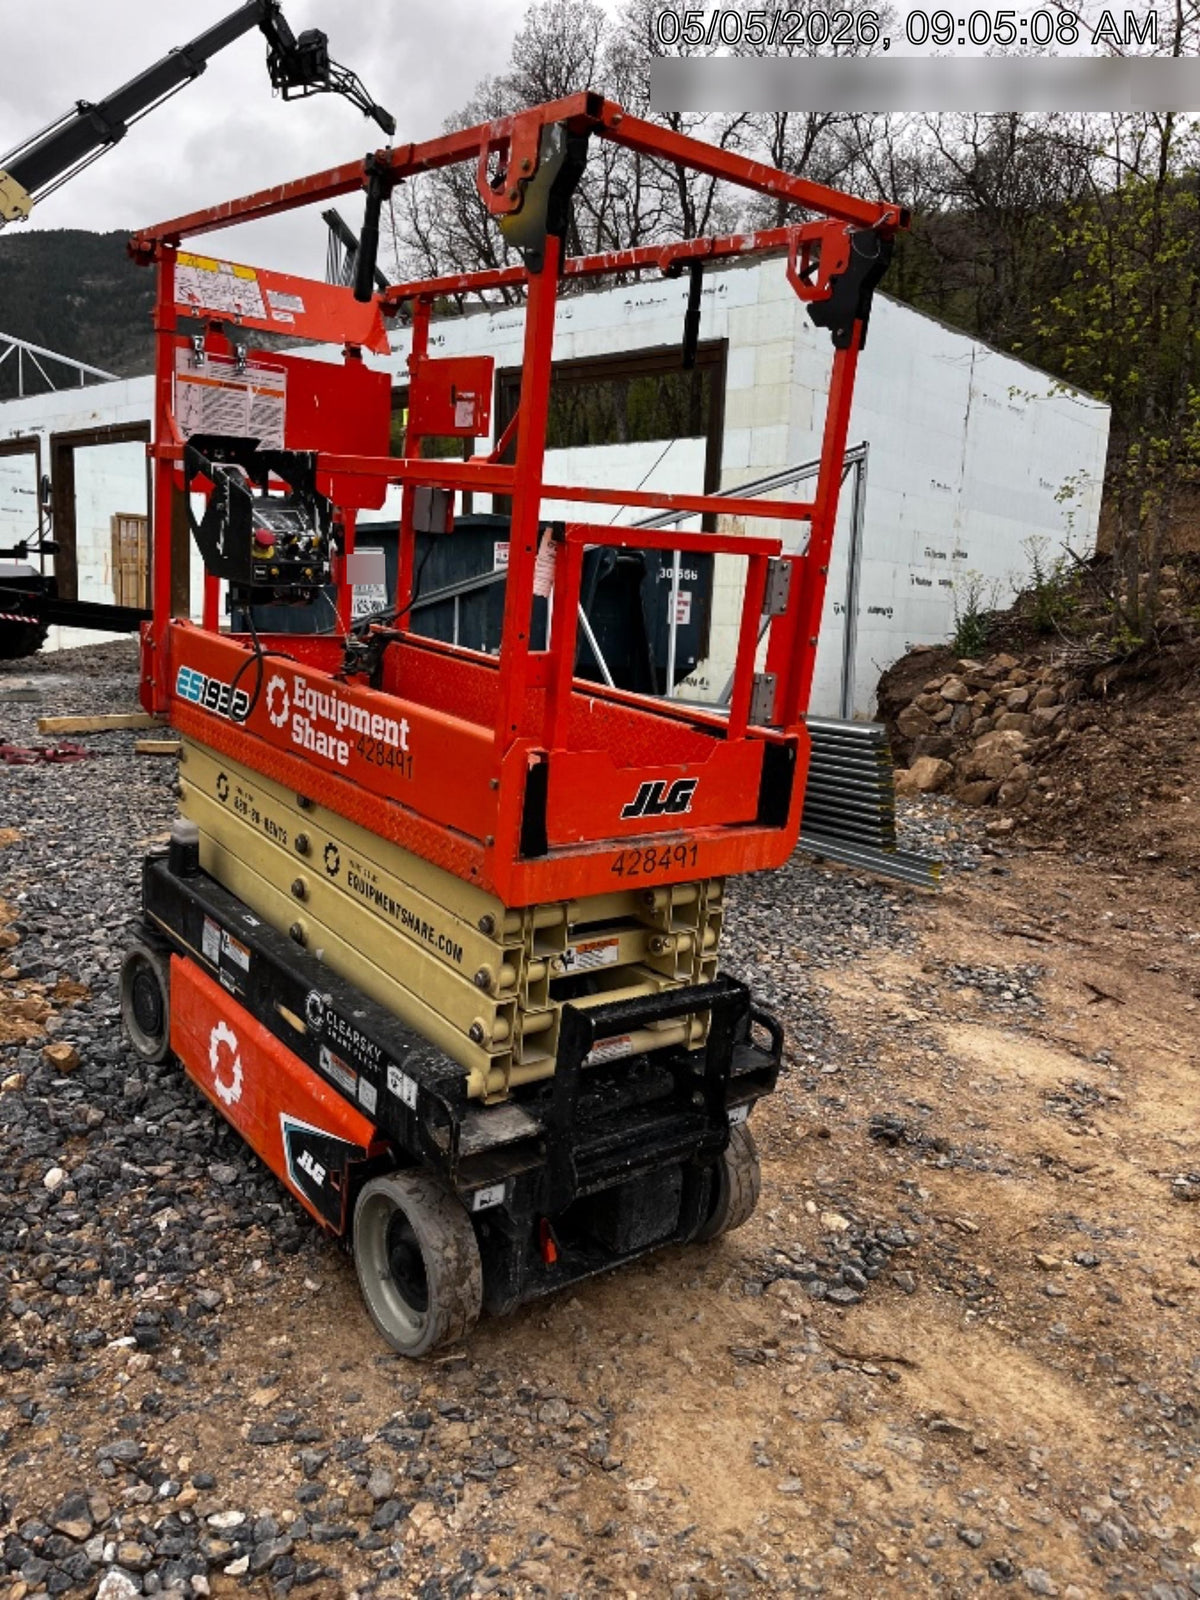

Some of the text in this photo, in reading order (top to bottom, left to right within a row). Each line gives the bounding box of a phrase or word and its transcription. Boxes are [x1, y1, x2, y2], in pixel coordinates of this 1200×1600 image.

[176, 665, 250, 725] ES1932
[292, 675, 410, 751] Equipment
[291, 713, 350, 766] Share
[356, 735, 413, 779] 428491
[620, 777, 700, 820] JLG
[611, 843, 698, 877] 428491
[347, 871, 463, 963] EQUIPMENTSHARE.COM
[326, 1010, 382, 1060] CLEARSKY
[296, 1149, 327, 1188] JLG
